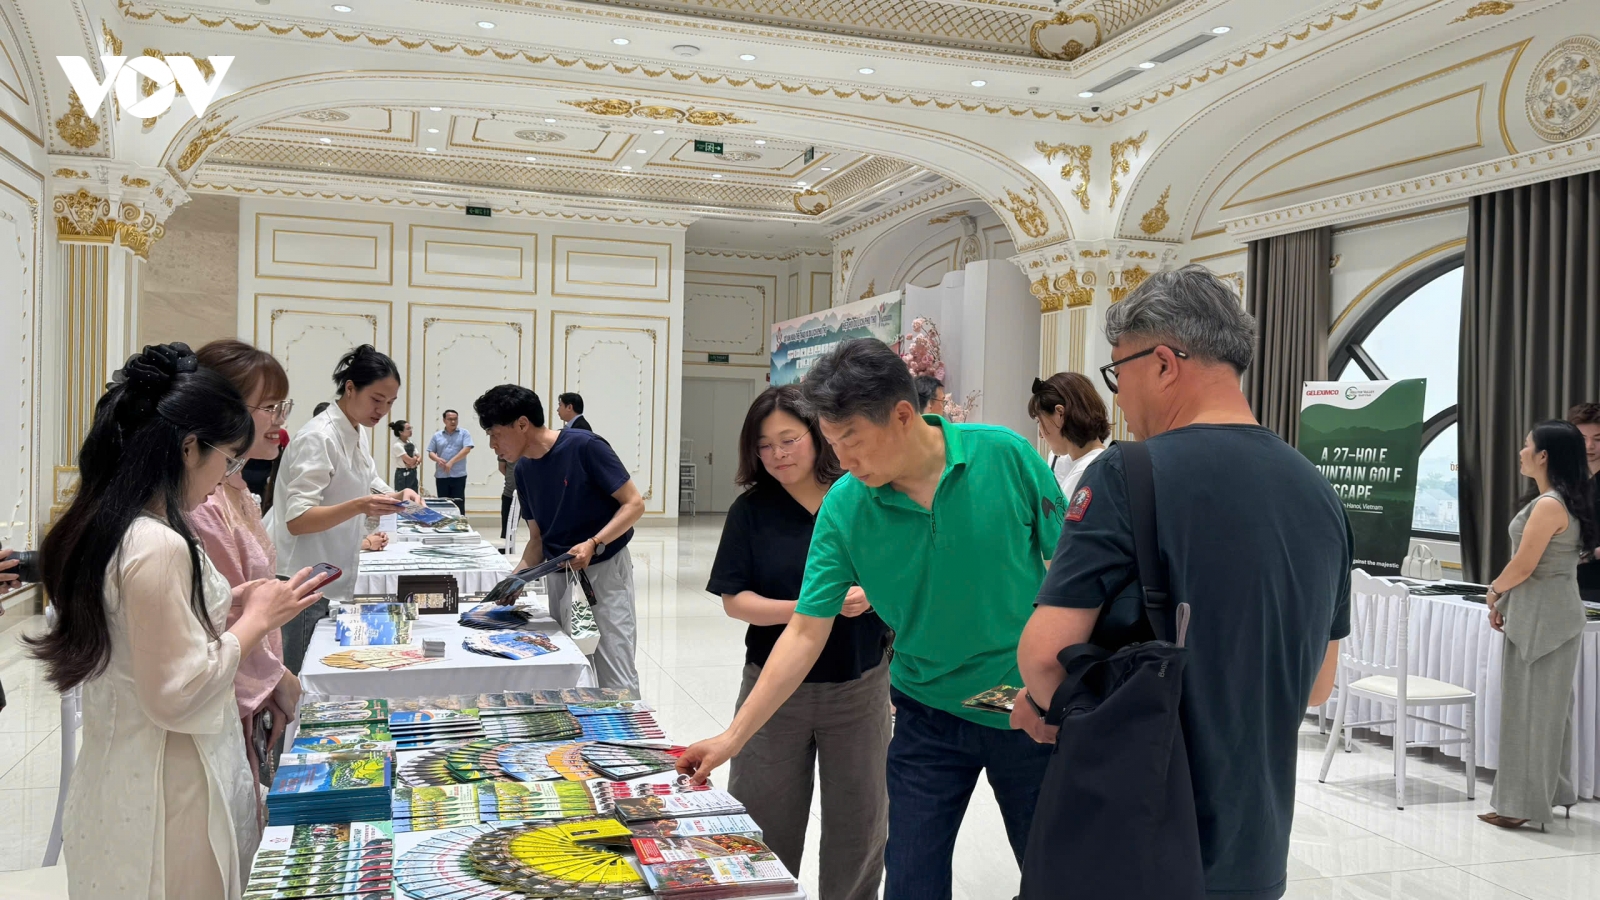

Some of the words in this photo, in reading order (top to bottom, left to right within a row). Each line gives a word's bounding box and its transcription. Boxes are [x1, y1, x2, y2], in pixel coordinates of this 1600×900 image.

[1321, 447, 1329, 462] A
[1333, 447, 1388, 464] 27-HOLE
[1315, 464, 1366, 481] UNTAIN
[1369, 466, 1403, 483] GOLF
[1330, 483, 1373, 500] SCAPE
[1363, 503, 1384, 511] Vietnam
[1376, 561, 1400, 569] majestic
